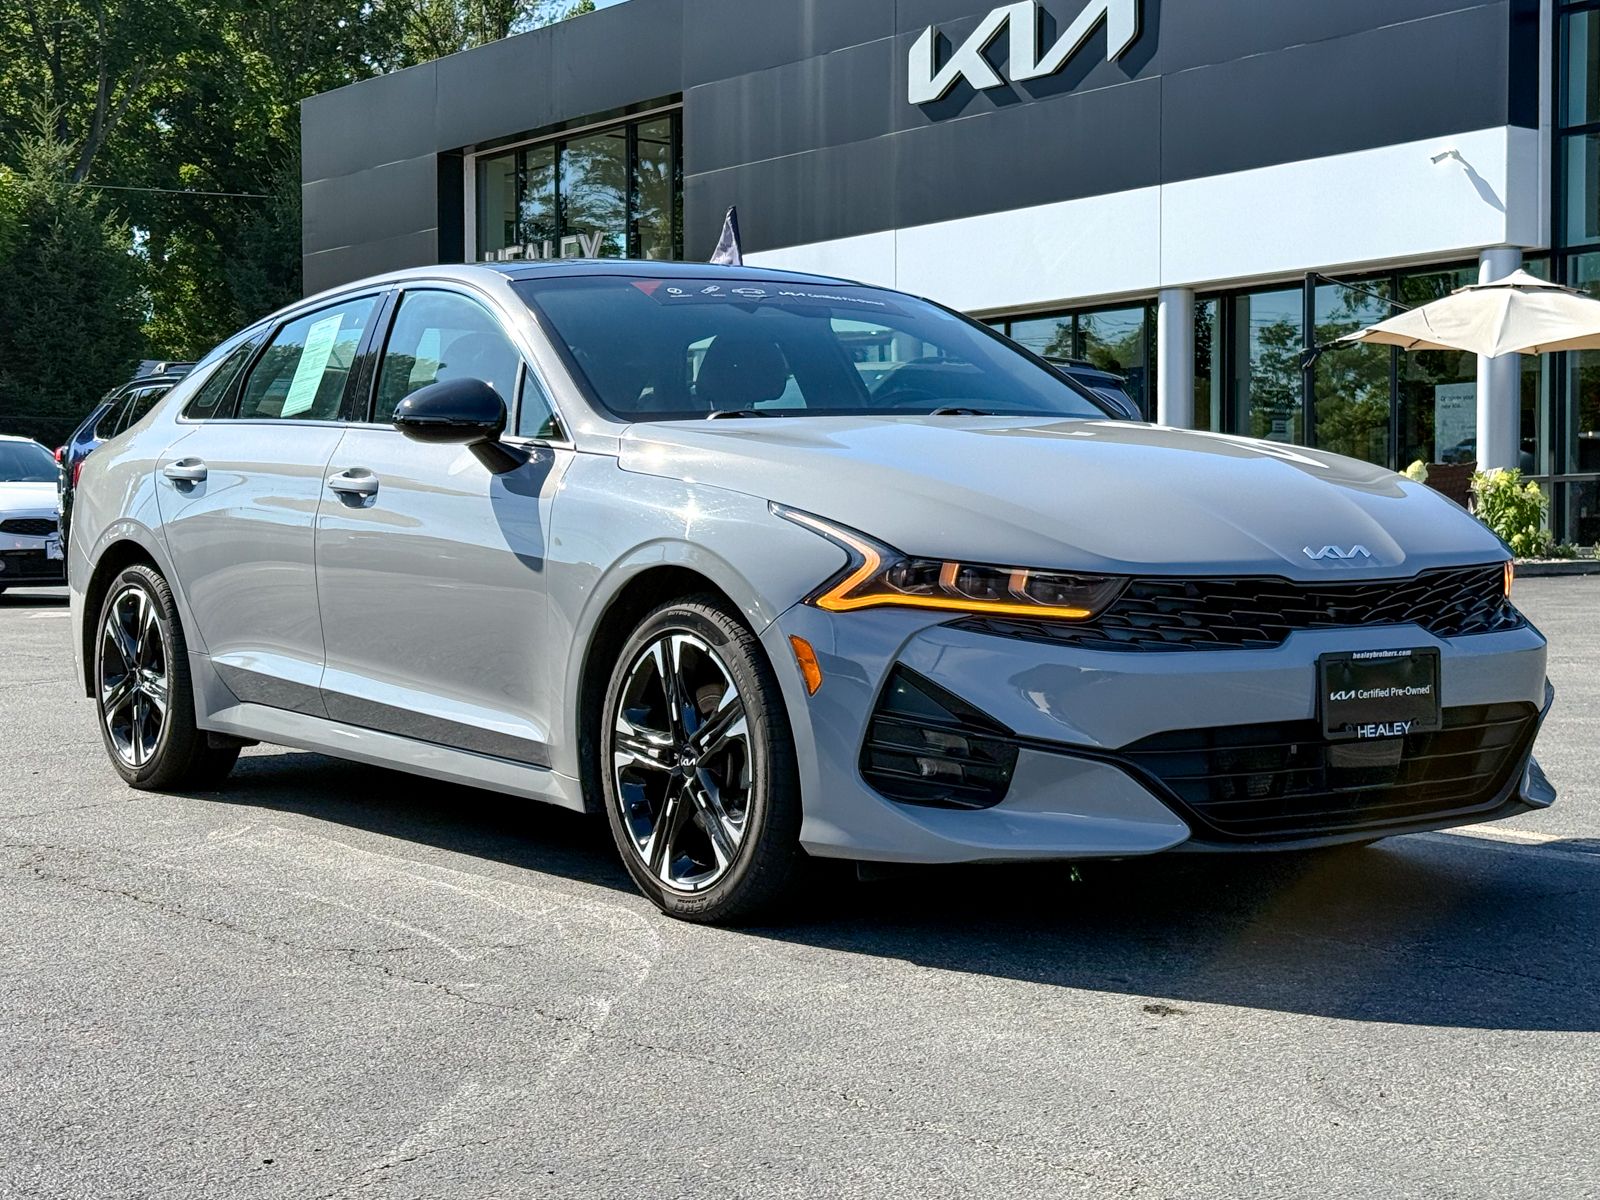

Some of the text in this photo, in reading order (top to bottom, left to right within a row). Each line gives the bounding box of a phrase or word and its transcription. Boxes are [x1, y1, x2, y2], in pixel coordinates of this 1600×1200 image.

[908, 0, 1139, 104] KIA
[485, 231, 603, 261] AEY
[1302, 544, 1371, 560] KIA
[1352, 650, 1412, 659] healeybrothers.com
[1330, 690, 1356, 701] KIA
[1358, 688, 1390, 700] Certified
[1357, 721, 1412, 738] HEALEY
[681, 757, 696, 767] KIA
